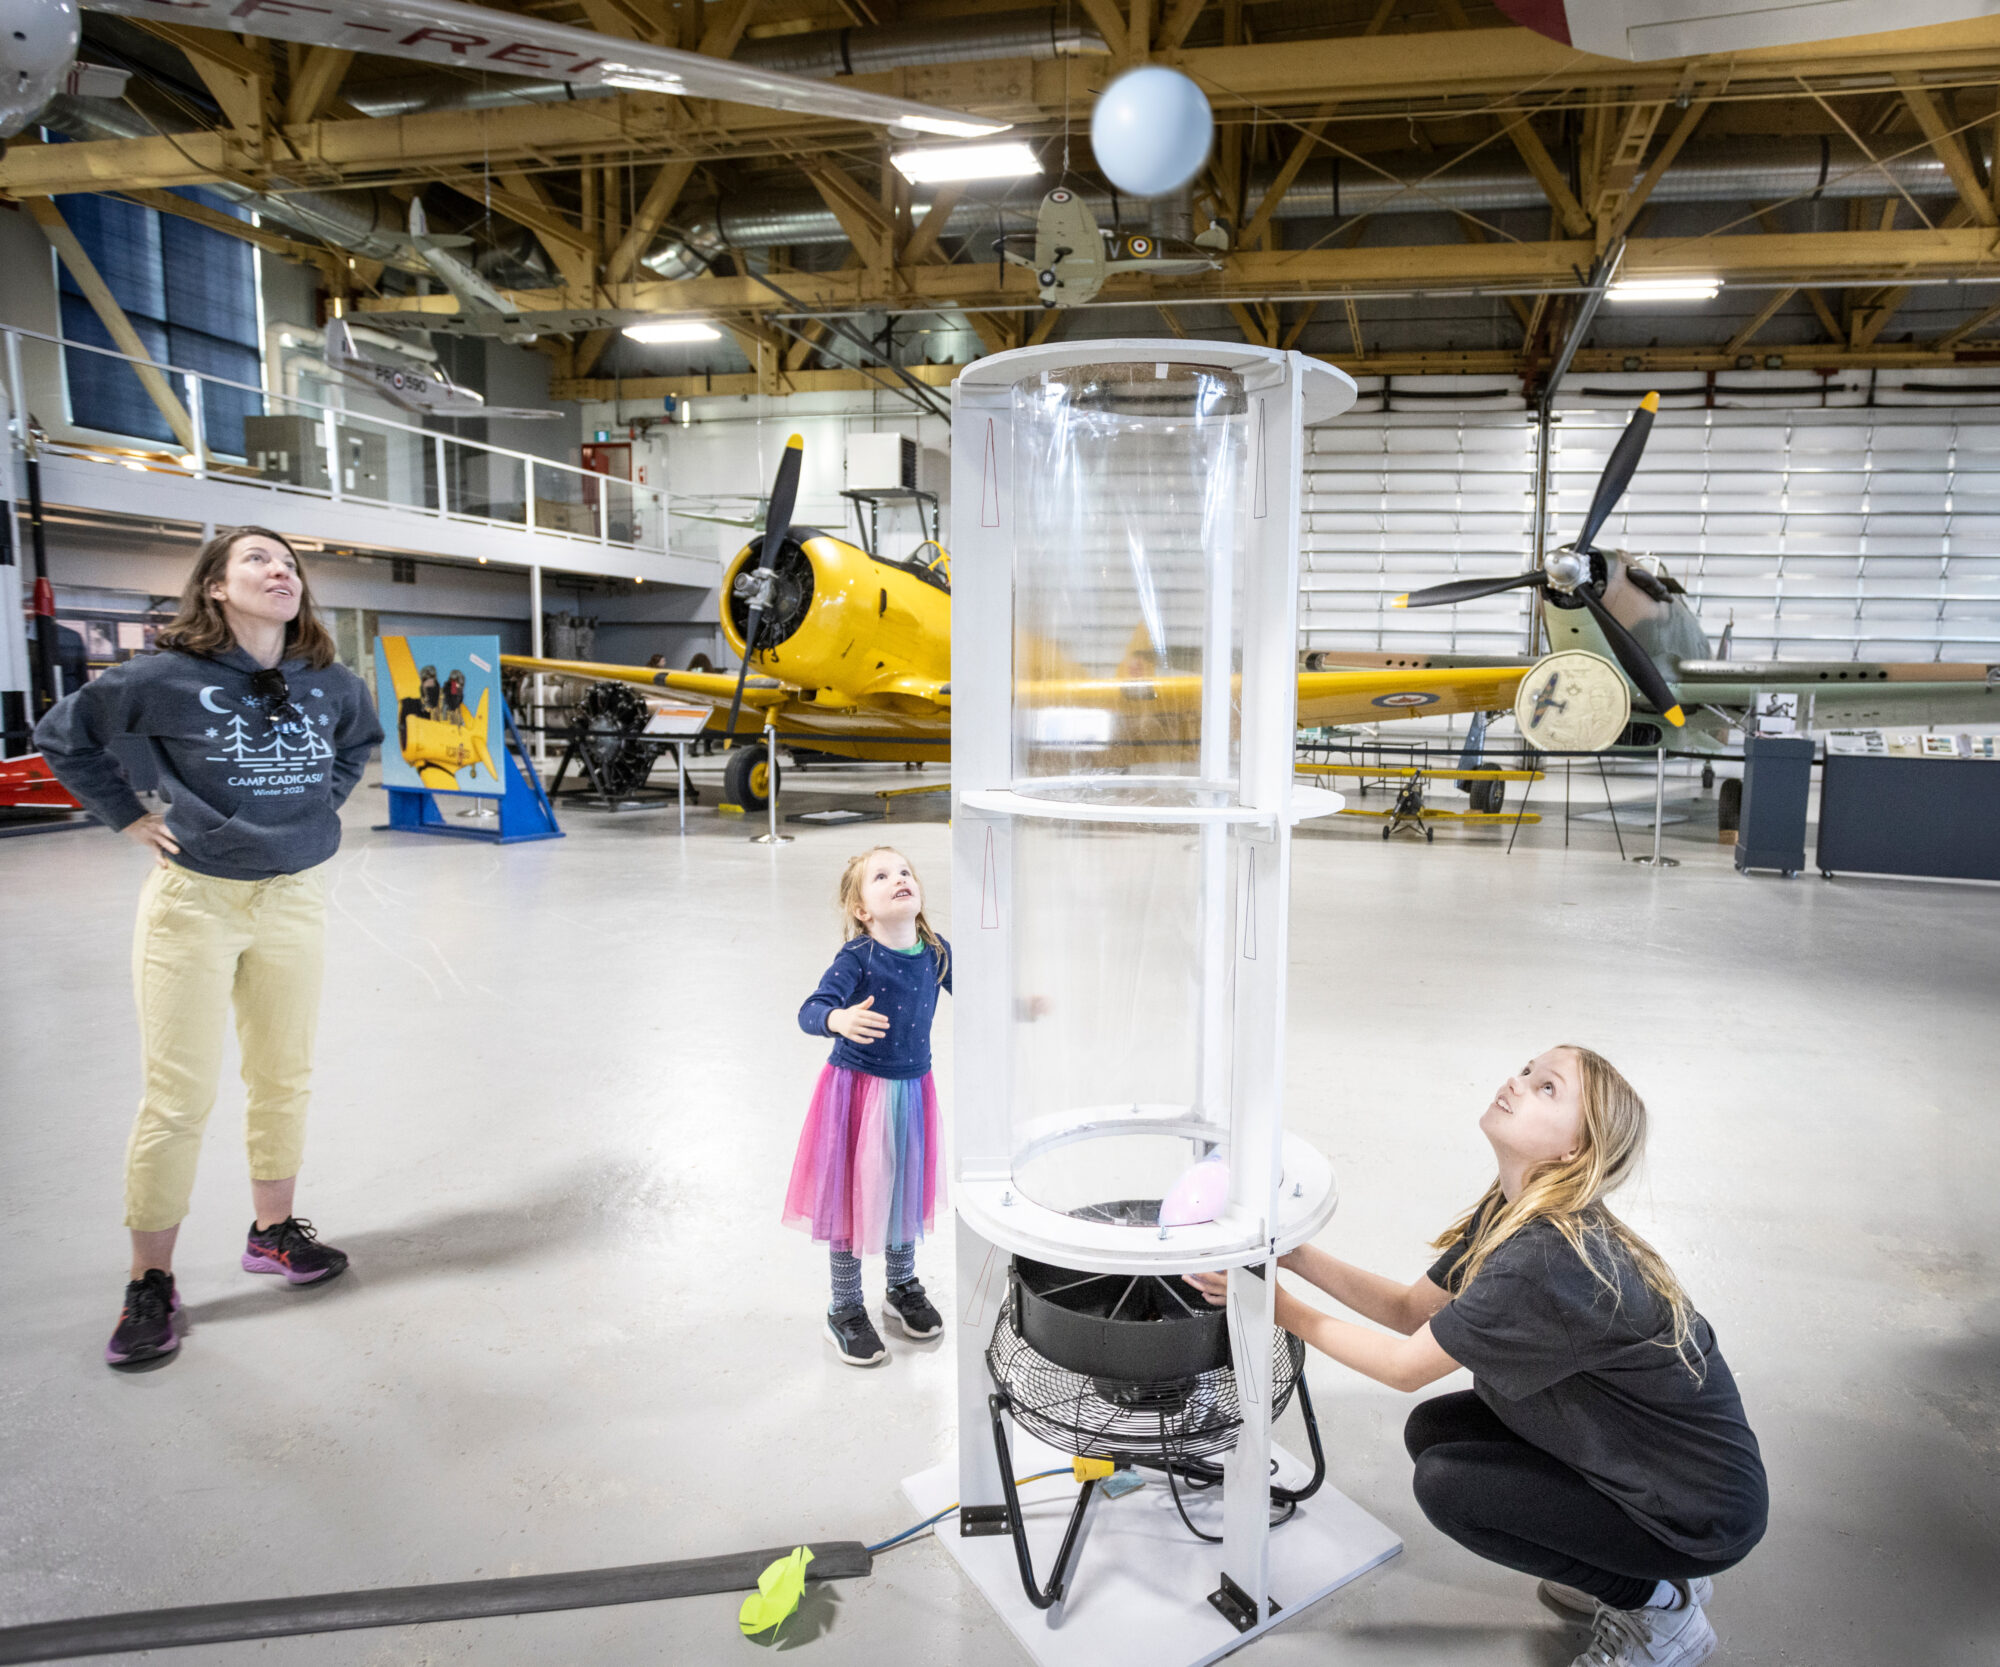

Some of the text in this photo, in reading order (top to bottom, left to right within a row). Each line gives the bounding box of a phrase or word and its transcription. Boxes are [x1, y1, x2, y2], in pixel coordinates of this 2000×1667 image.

[1108, 240, 1121, 259] V
[228, 776, 266, 787] CAMP
[253, 785, 305, 796] Winter 2023
